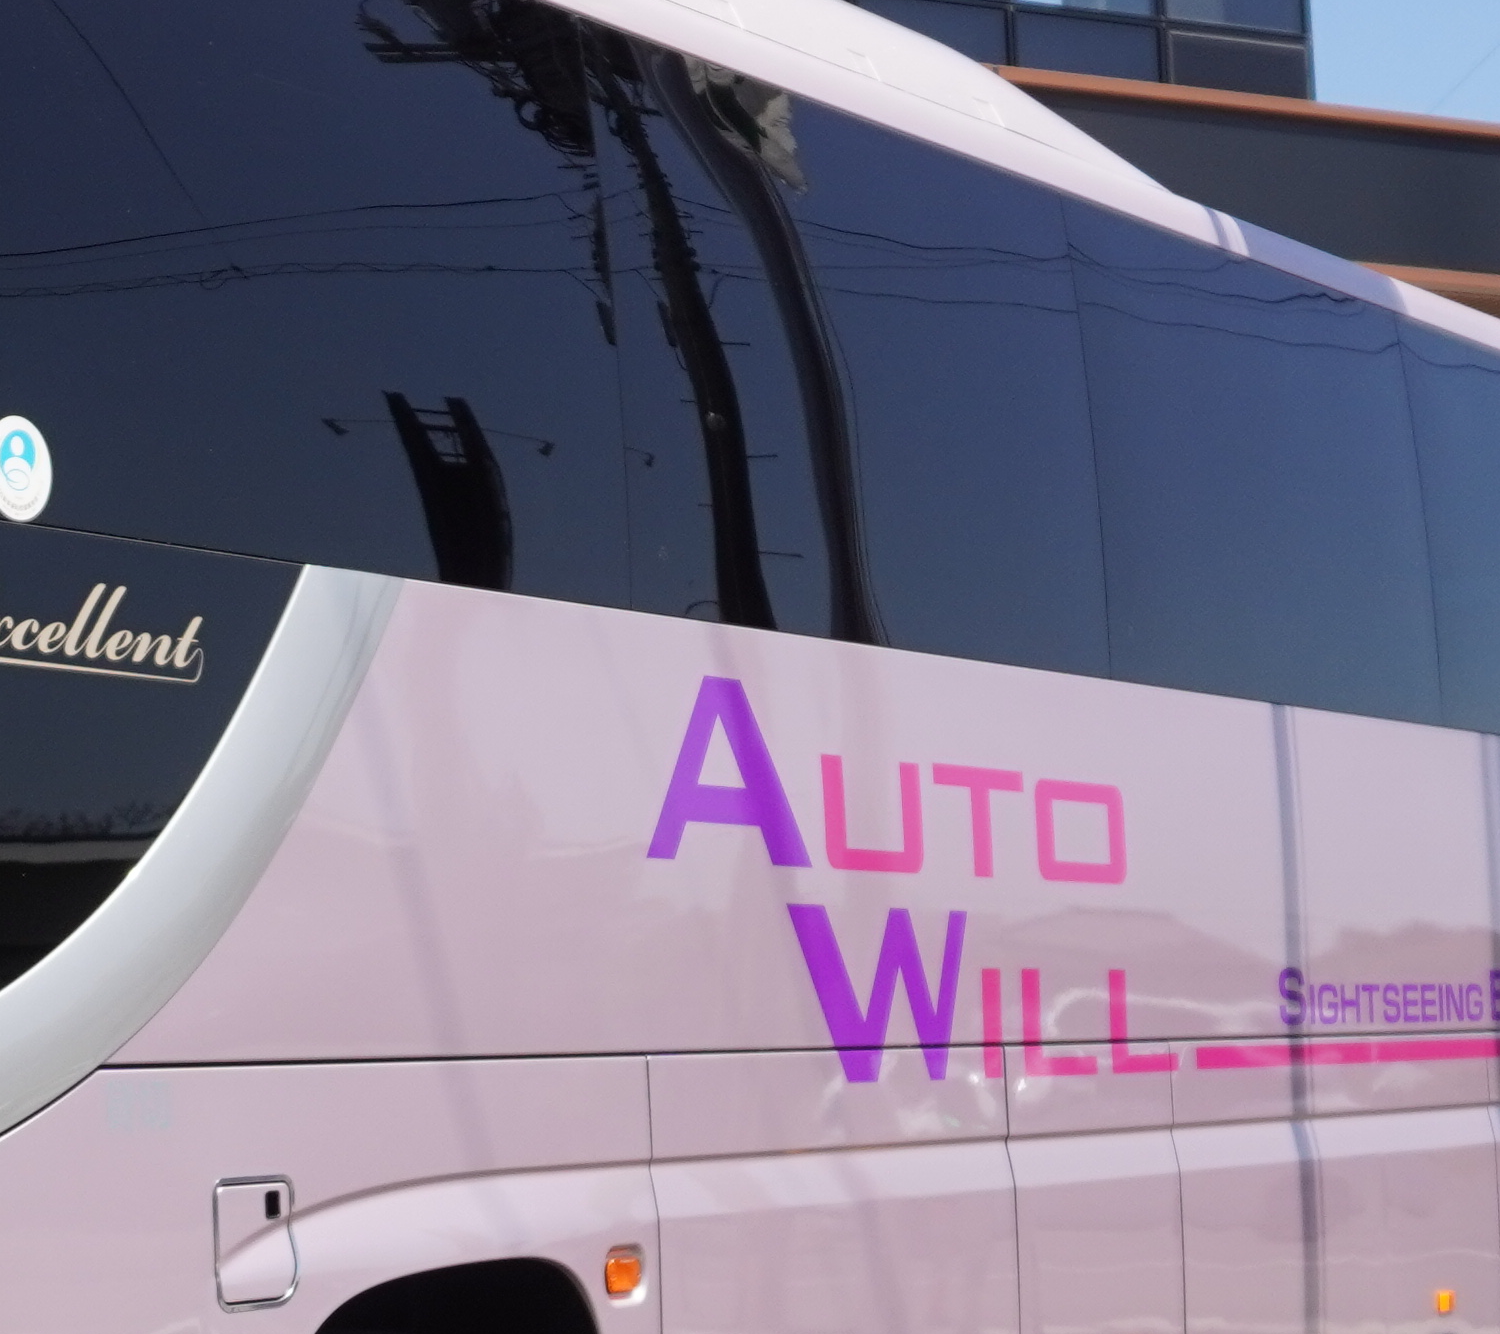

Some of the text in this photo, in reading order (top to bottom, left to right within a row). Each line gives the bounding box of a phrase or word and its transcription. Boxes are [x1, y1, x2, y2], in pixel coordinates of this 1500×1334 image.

[647, 675, 1126, 884] AUTO
[786, 903, 1179, 1083] WILL
[1278, 967, 1484, 1026] SIGHTSEEING
